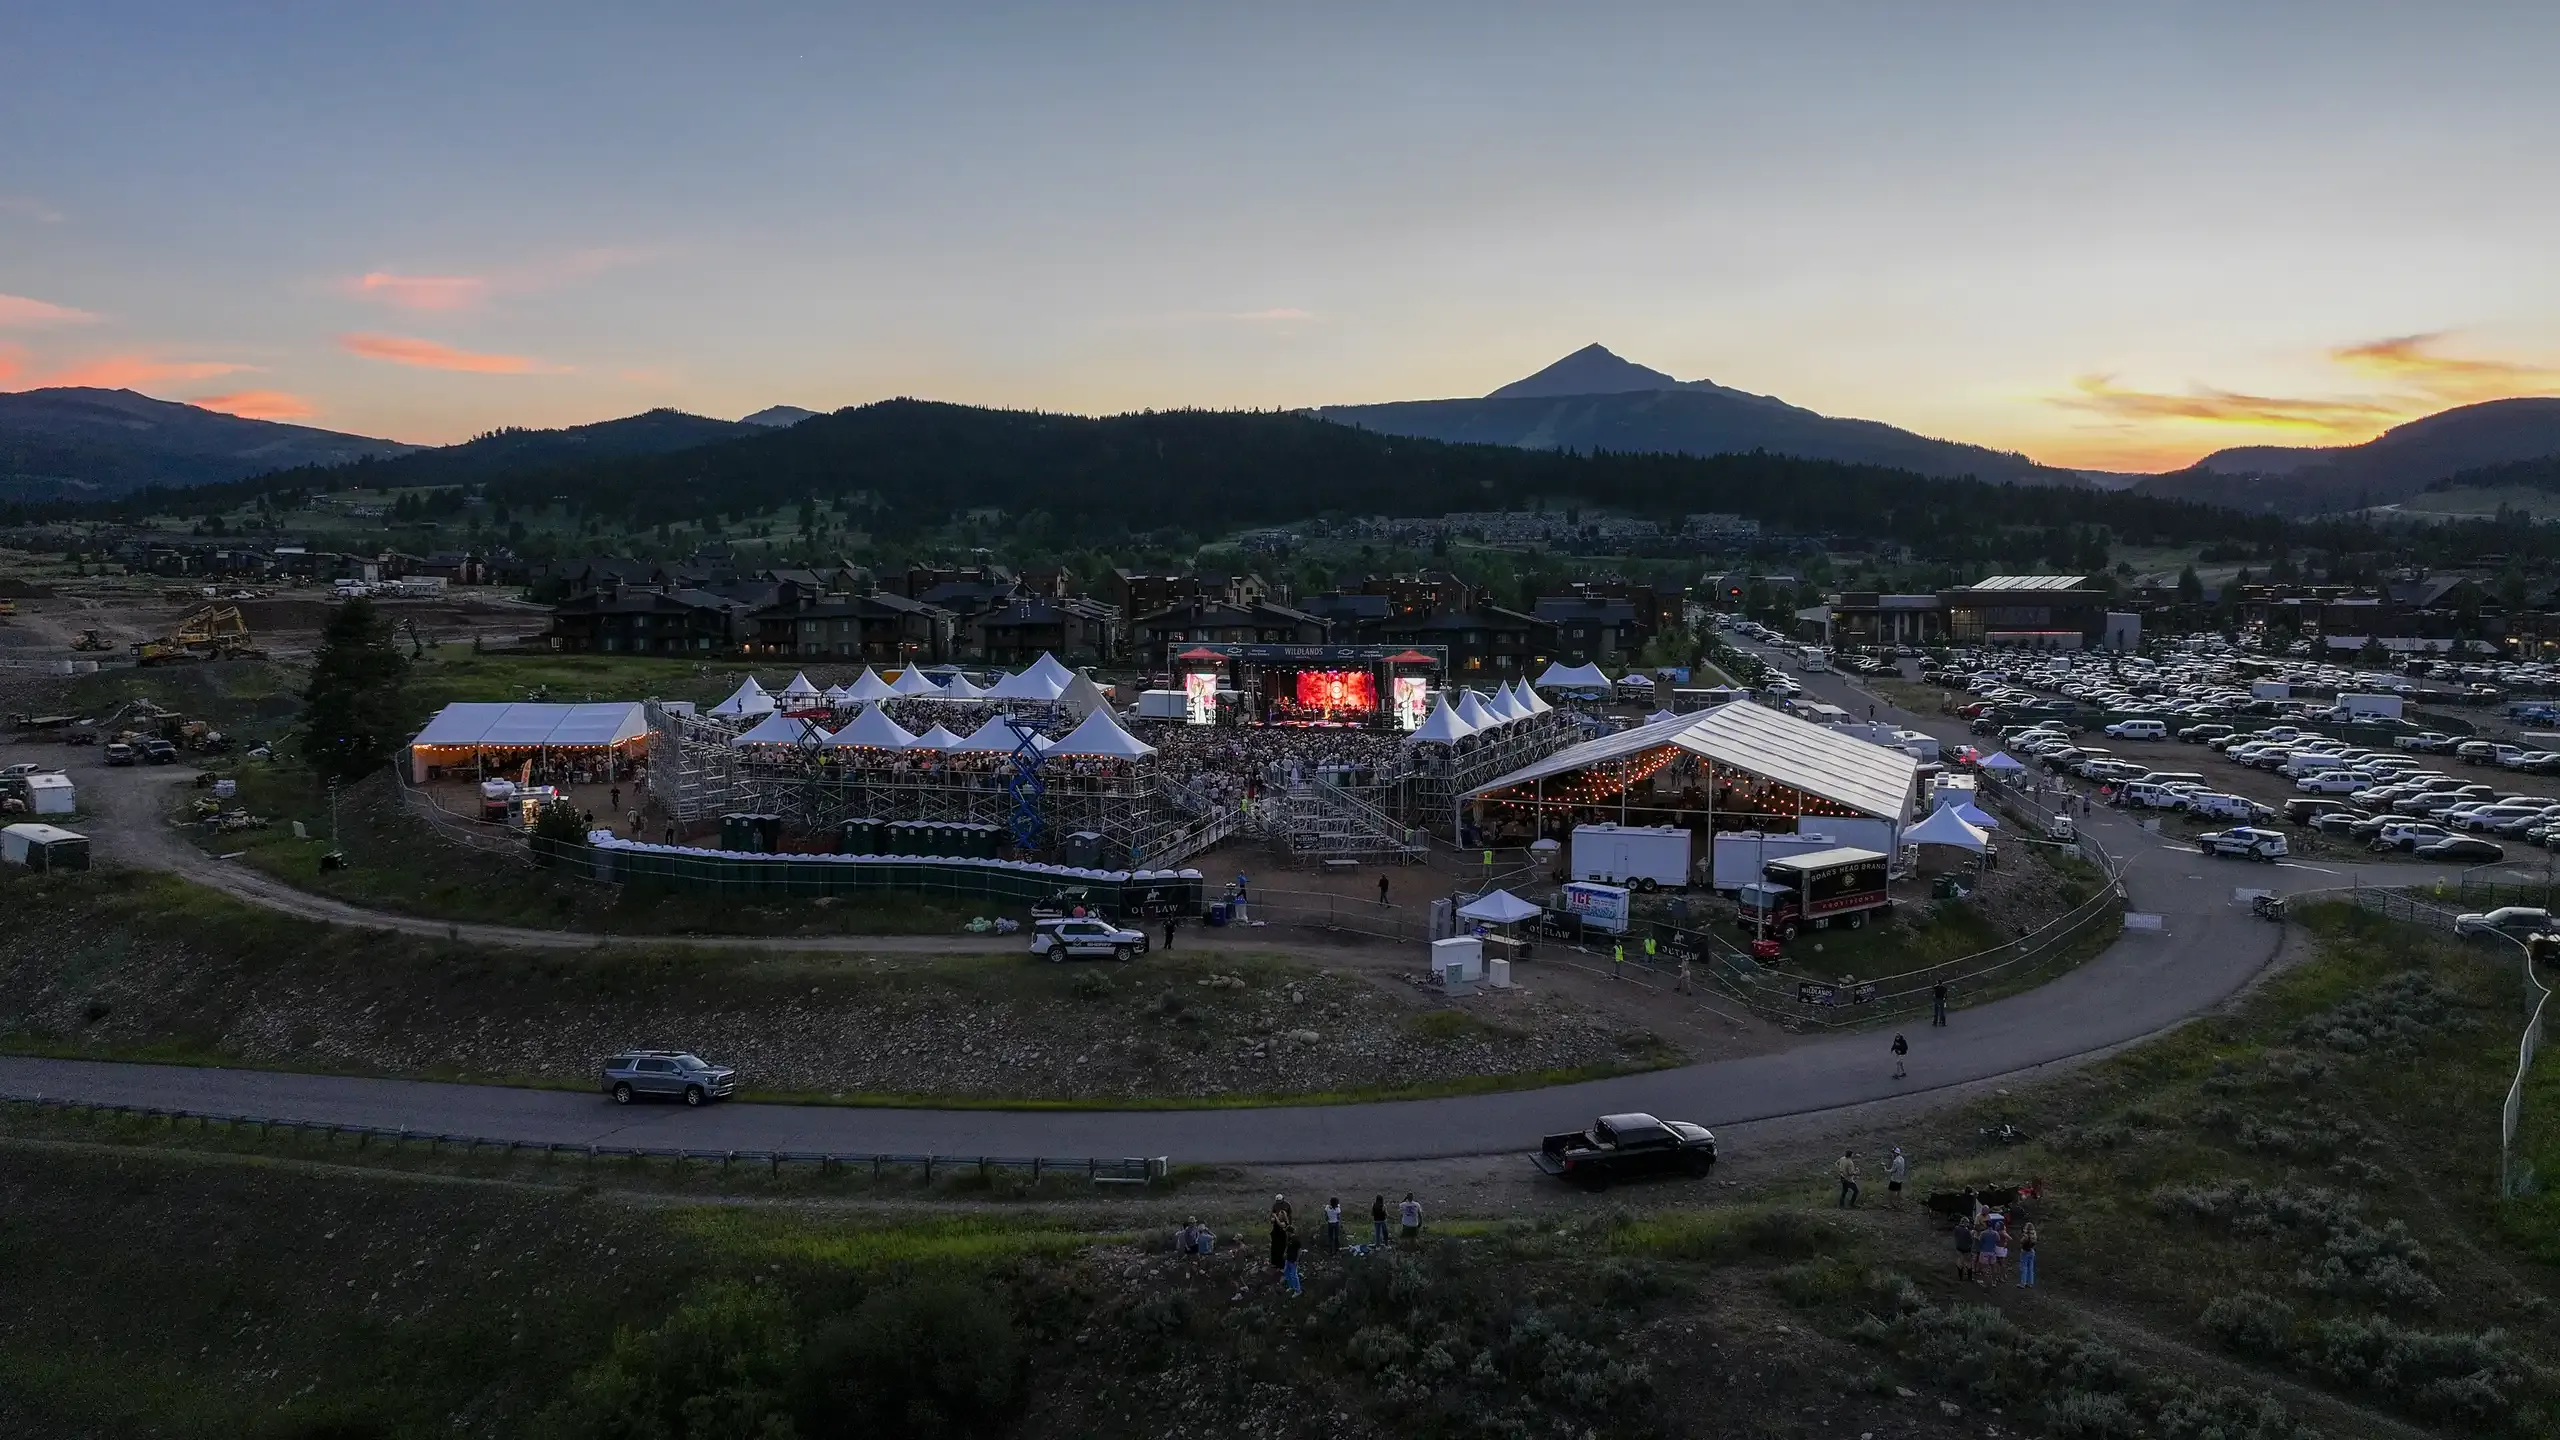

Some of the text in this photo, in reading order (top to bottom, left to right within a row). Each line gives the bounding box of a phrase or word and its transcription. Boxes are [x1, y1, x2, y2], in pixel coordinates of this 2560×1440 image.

[1284, 647, 1324, 656] WILDLANDS
[1810, 863, 1887, 882] BOAR'S HEAD BRAND
